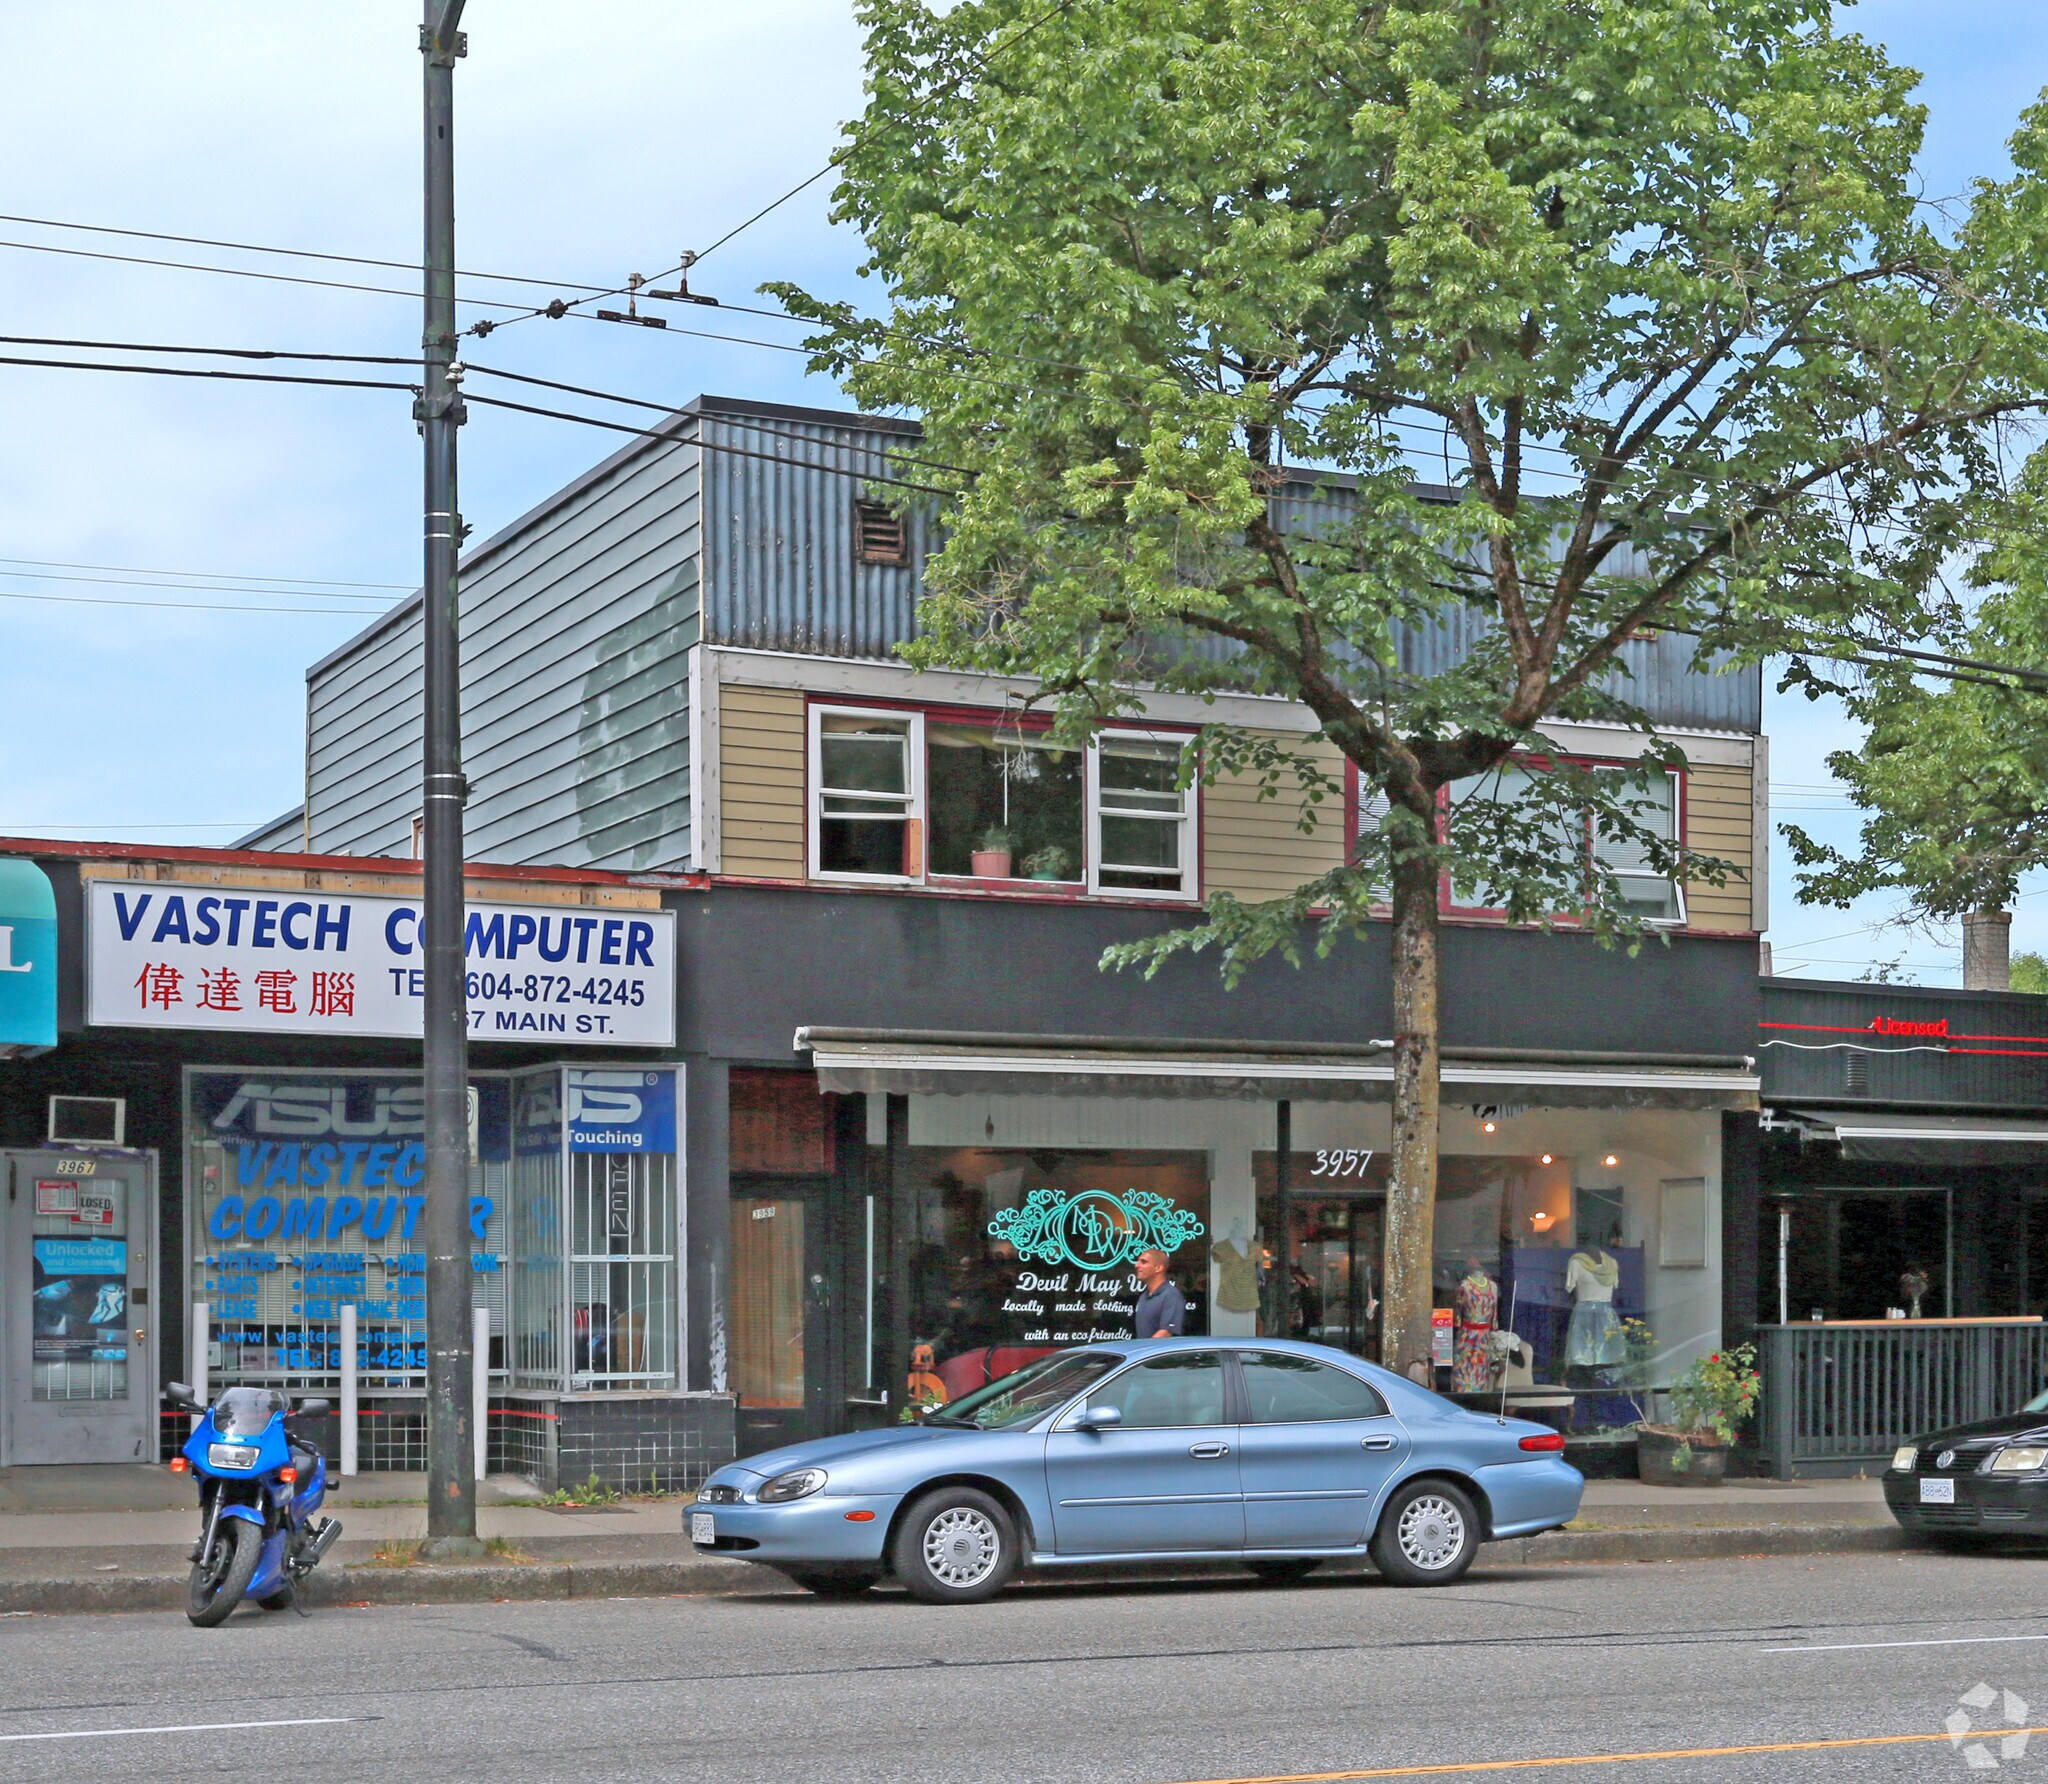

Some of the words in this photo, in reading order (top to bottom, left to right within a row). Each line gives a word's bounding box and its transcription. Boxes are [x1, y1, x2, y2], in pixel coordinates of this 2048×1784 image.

[113, 892, 351, 951] VASTECH
[385, 907, 655, 967] CMPUTER
[134, 962, 355, 1017] 偉達電腦
[389, 968, 425, 997] TE
[465, 971, 645, 1007] 604-872-4245
[495, 1011, 566, 1033] MAIN
[575, 1013, 614, 1035] ST.
[1874, 1015, 1948, 1037] Licensed
[58, 1161, 95, 1174] 3967
[238, 1142, 426, 1188] VASTEC
[1310, 1149, 1373, 1177] 3957
[80, 1197, 111, 1211] LOSED
[208, 1195, 493, 1239] COMPUTR
[46, 1243, 114, 1257] Unlocked
[1016, 1272, 1069, 1292] Devil
[1075, 1273, 1123, 1297] May
[1001, 1299, 1044, 1316] locally
[1055, 1300, 1086, 1312] made
[1093, 1299, 1134, 1317] clothing
[1025, 1328, 1050, 1341] with
[1053, 1332, 1070, 1341] an
[275, 1349, 322, 1367] TEL:
[330, 1349, 427, 1367] 82-4245
